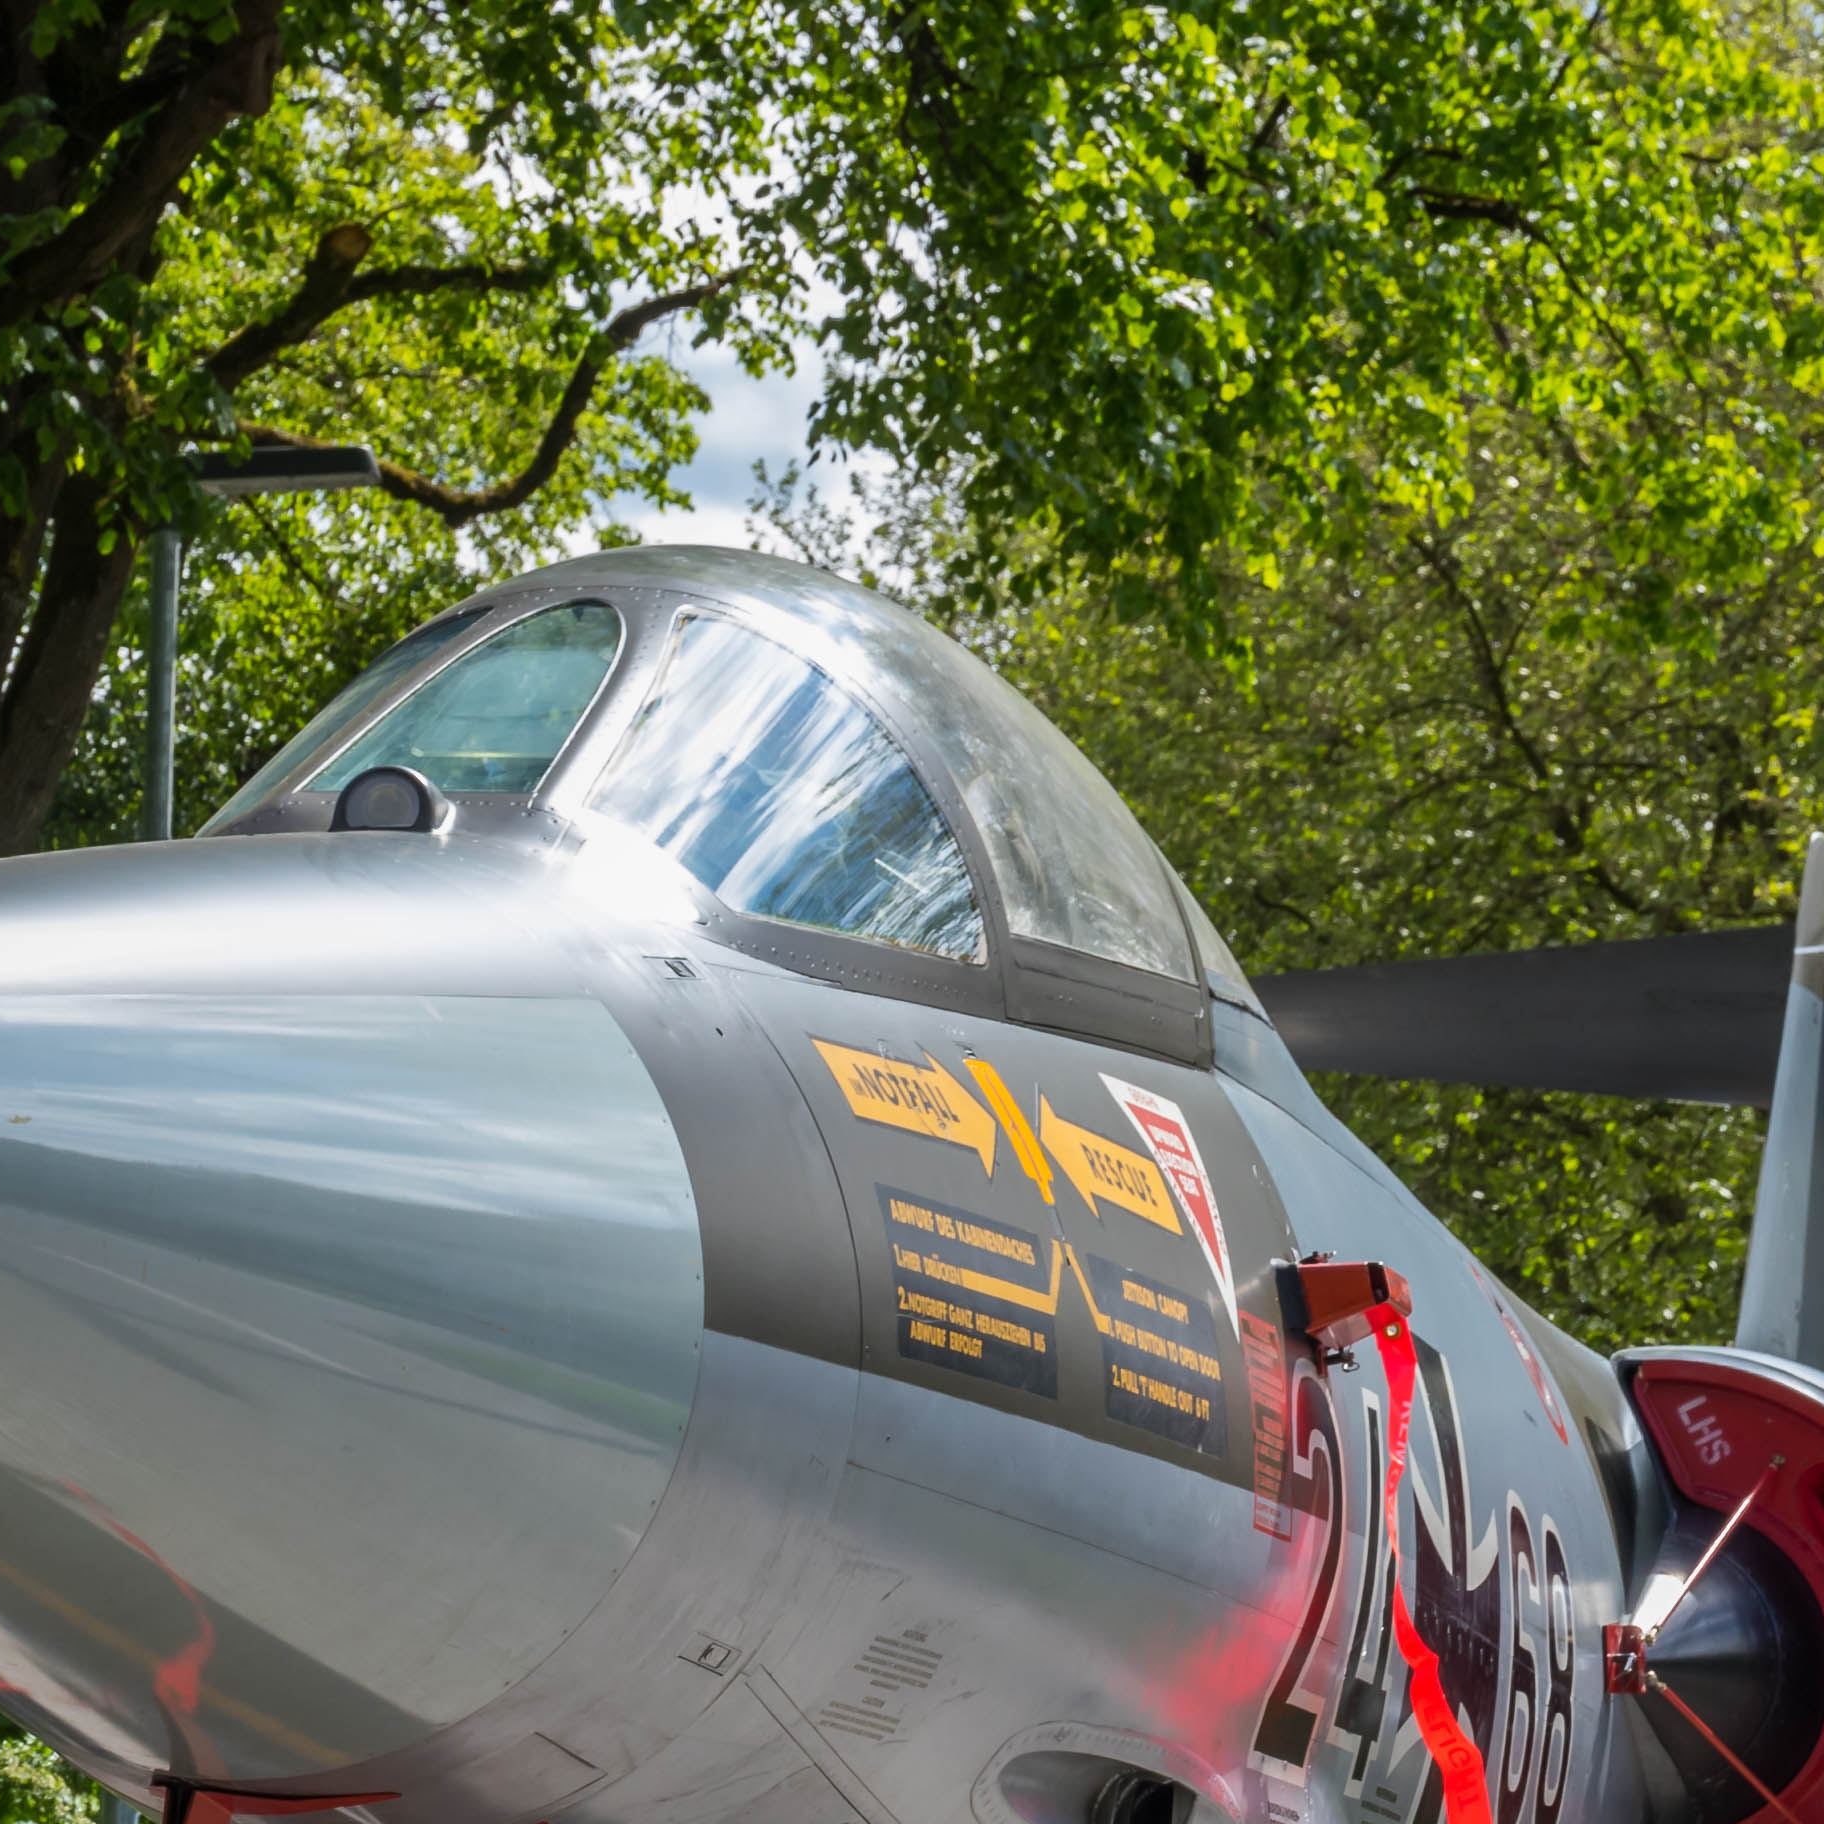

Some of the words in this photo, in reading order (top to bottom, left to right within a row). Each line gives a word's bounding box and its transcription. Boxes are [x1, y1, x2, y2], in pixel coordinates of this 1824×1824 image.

[853, 1063, 960, 1124] NOTFALL
[1080, 1141, 1159, 1208] RESCUE
[889, 1198, 935, 1233] ABWURF
[935, 1212, 957, 1240] DES
[909, 1319, 947, 1349] ABWURF
[949, 1330, 984, 1359] ERFOLGT
[948, 1303, 975, 1329] GANZ
[1033, 1331, 1047, 1353] BIS
[1113, 1318, 1138, 1347] PUSH
[1136, 1327, 1168, 1359] BUTTON
[1167, 1339, 1179, 1364] TO
[1178, 1345, 1200, 1372] OPEN
[1199, 1353, 1222, 1382] DOOR
[1120, 1367, 1140, 1396] PULL
[1177, 1389, 1194, 1415] OUT
[1677, 1394, 1732, 1467] LHS
[1248, 1356, 1398, 1798] 24
